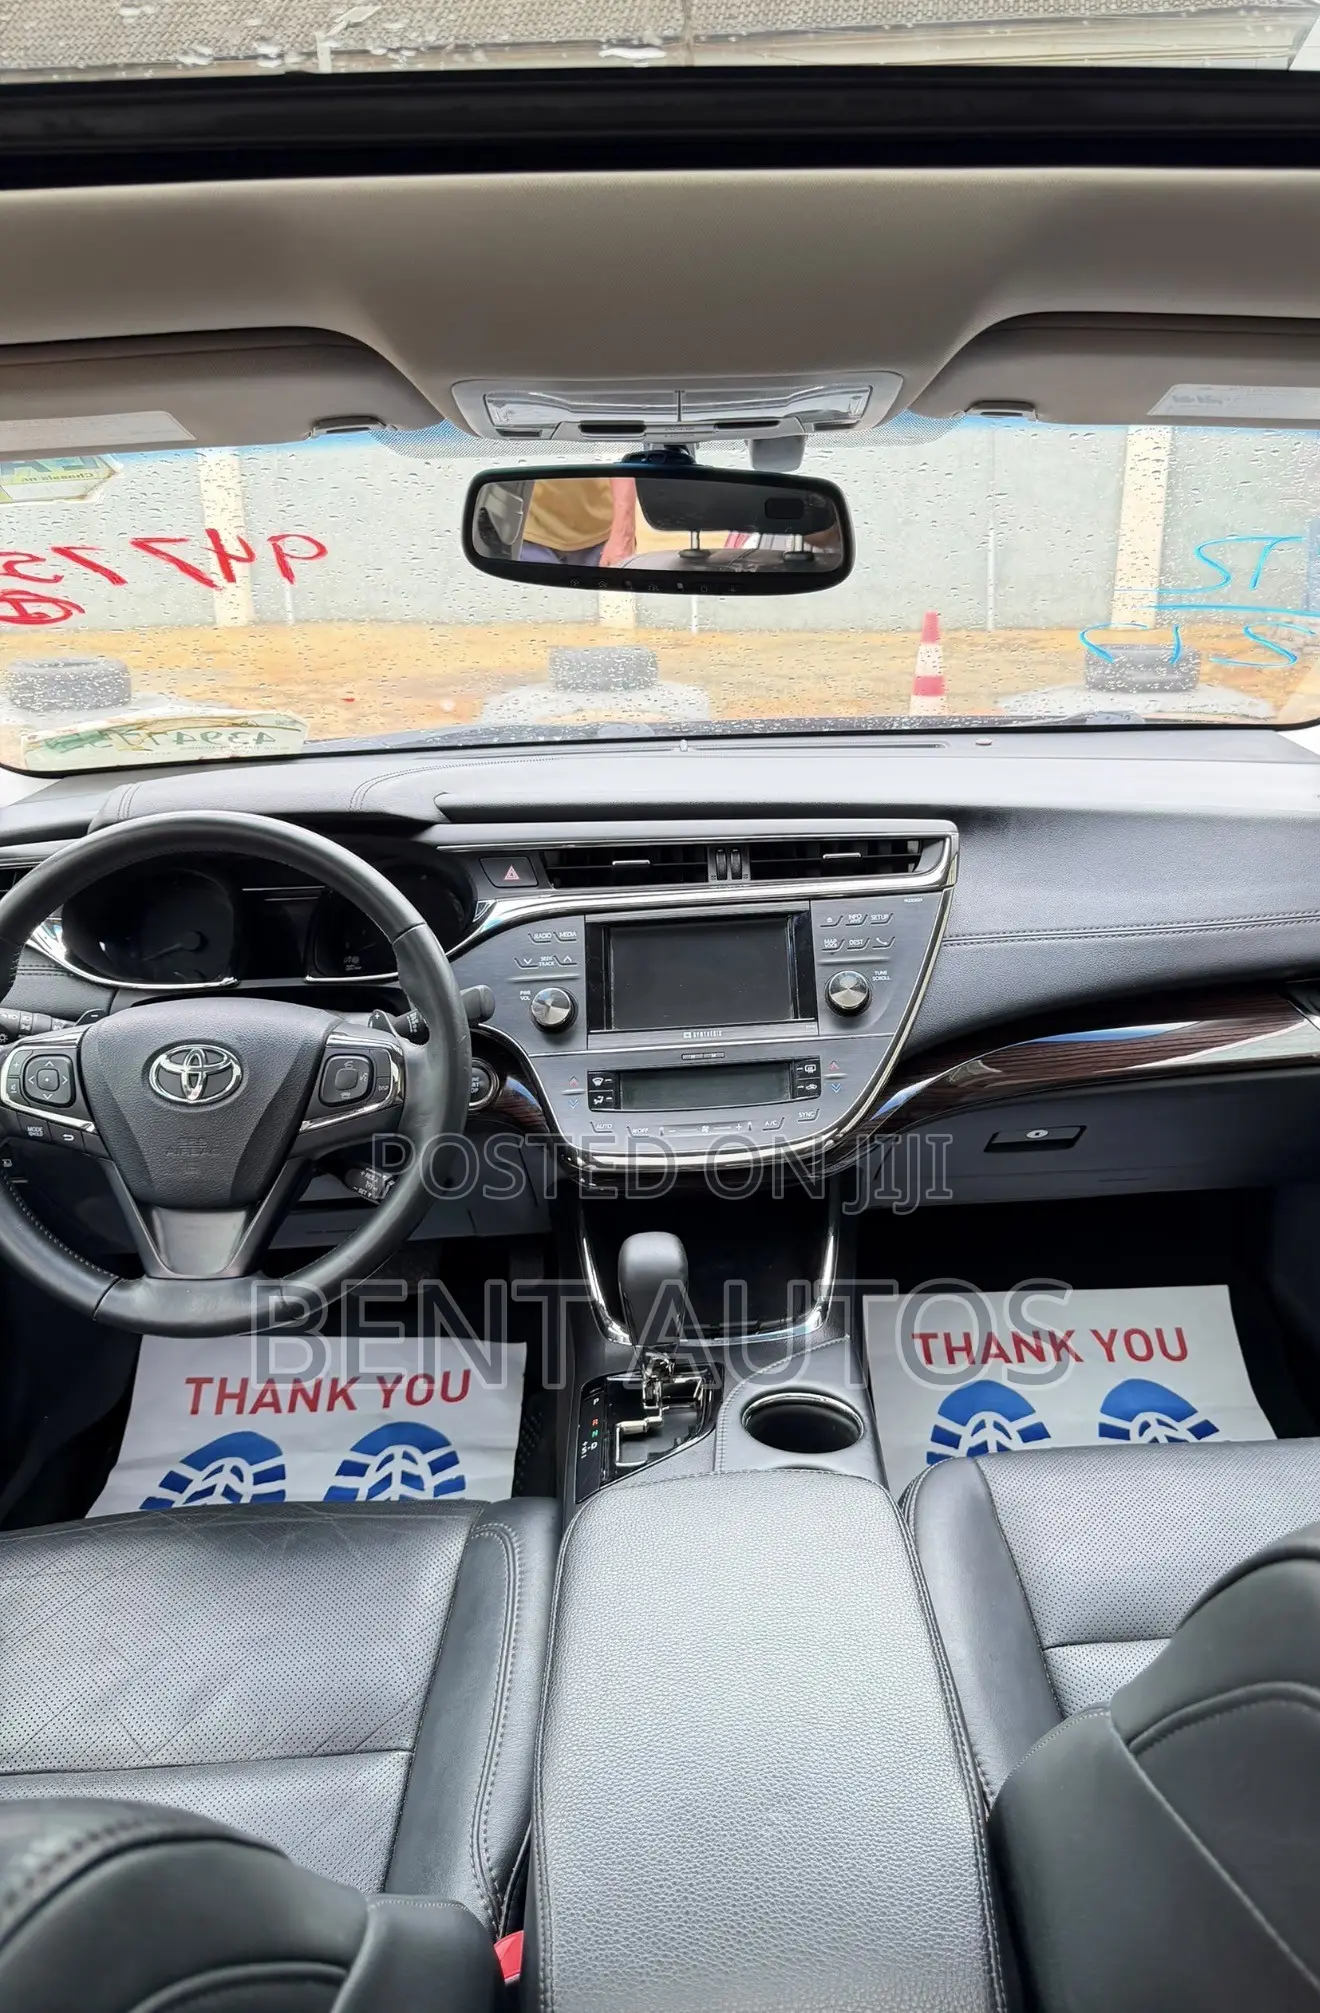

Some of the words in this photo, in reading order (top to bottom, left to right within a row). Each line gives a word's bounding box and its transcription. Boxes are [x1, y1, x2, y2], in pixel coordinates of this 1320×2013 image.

[911, 1328, 1084, 1366] THANK
[1089, 1326, 1188, 1363] YOU
[185, 1375, 360, 1416] THANK
[376, 1368, 471, 1410] YOU
[593, 1397, 600, 1406] P
[591, 1418, 599, 1426] R
[591, 1430, 599, 1438] N
